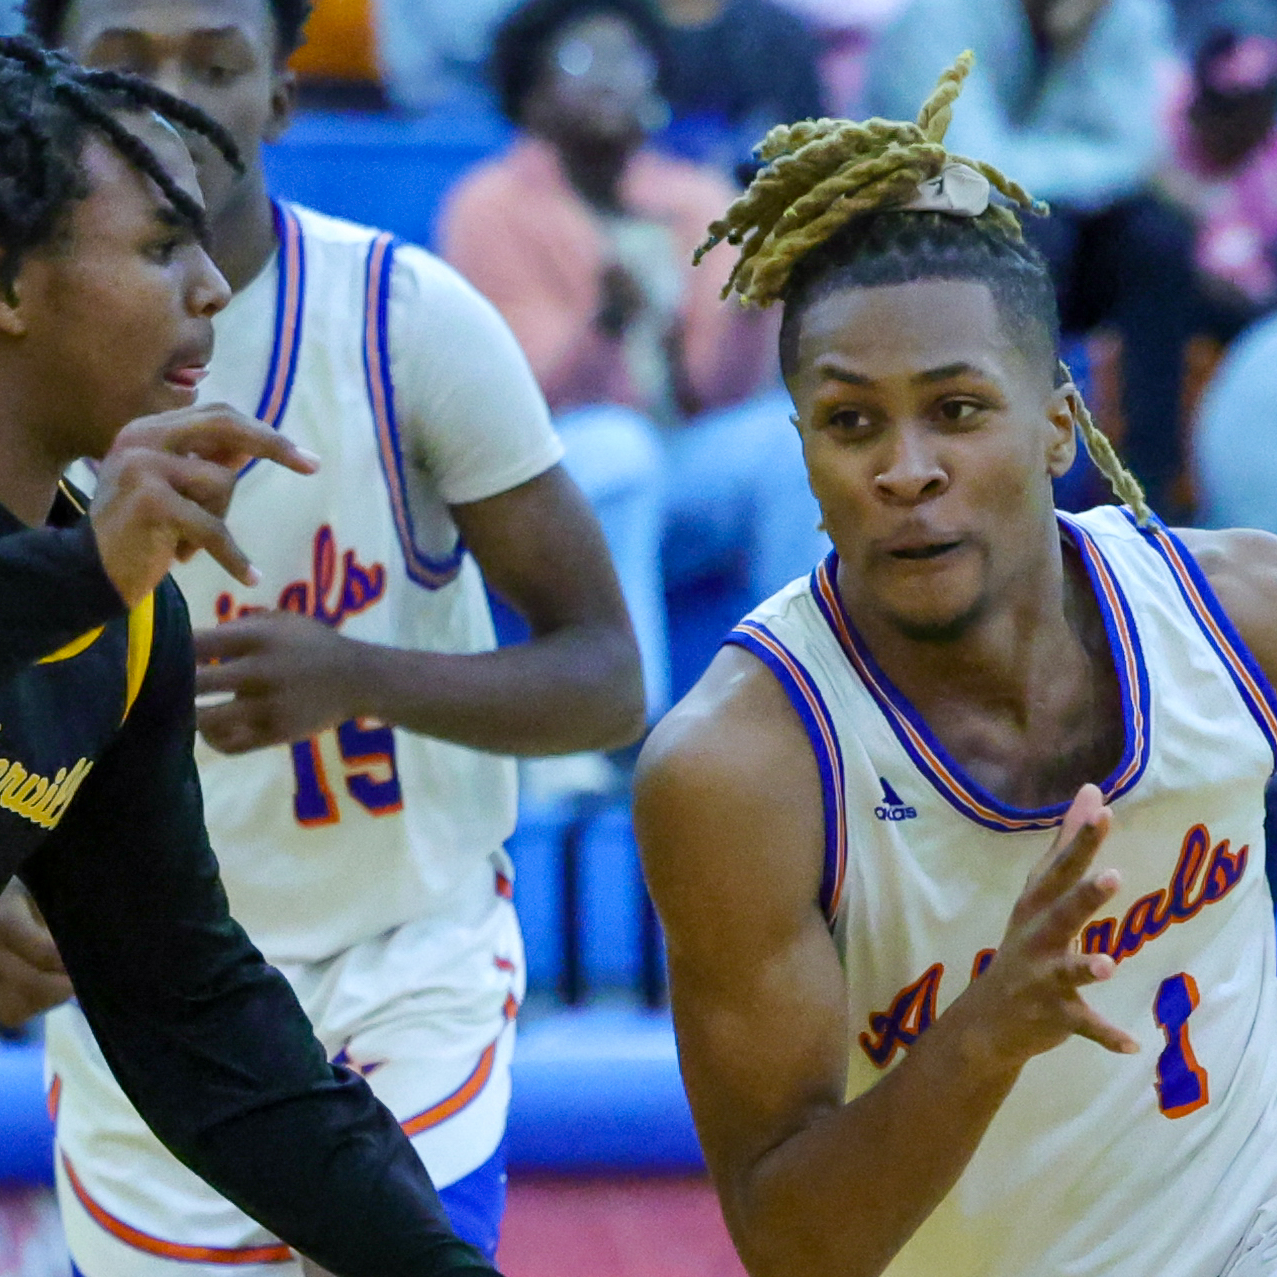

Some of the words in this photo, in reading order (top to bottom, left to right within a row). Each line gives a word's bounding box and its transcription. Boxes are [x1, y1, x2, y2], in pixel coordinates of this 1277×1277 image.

[290, 714, 405, 830] 15
[858, 823, 1250, 1070] Arals
[1153, 971, 1210, 1120] 1
